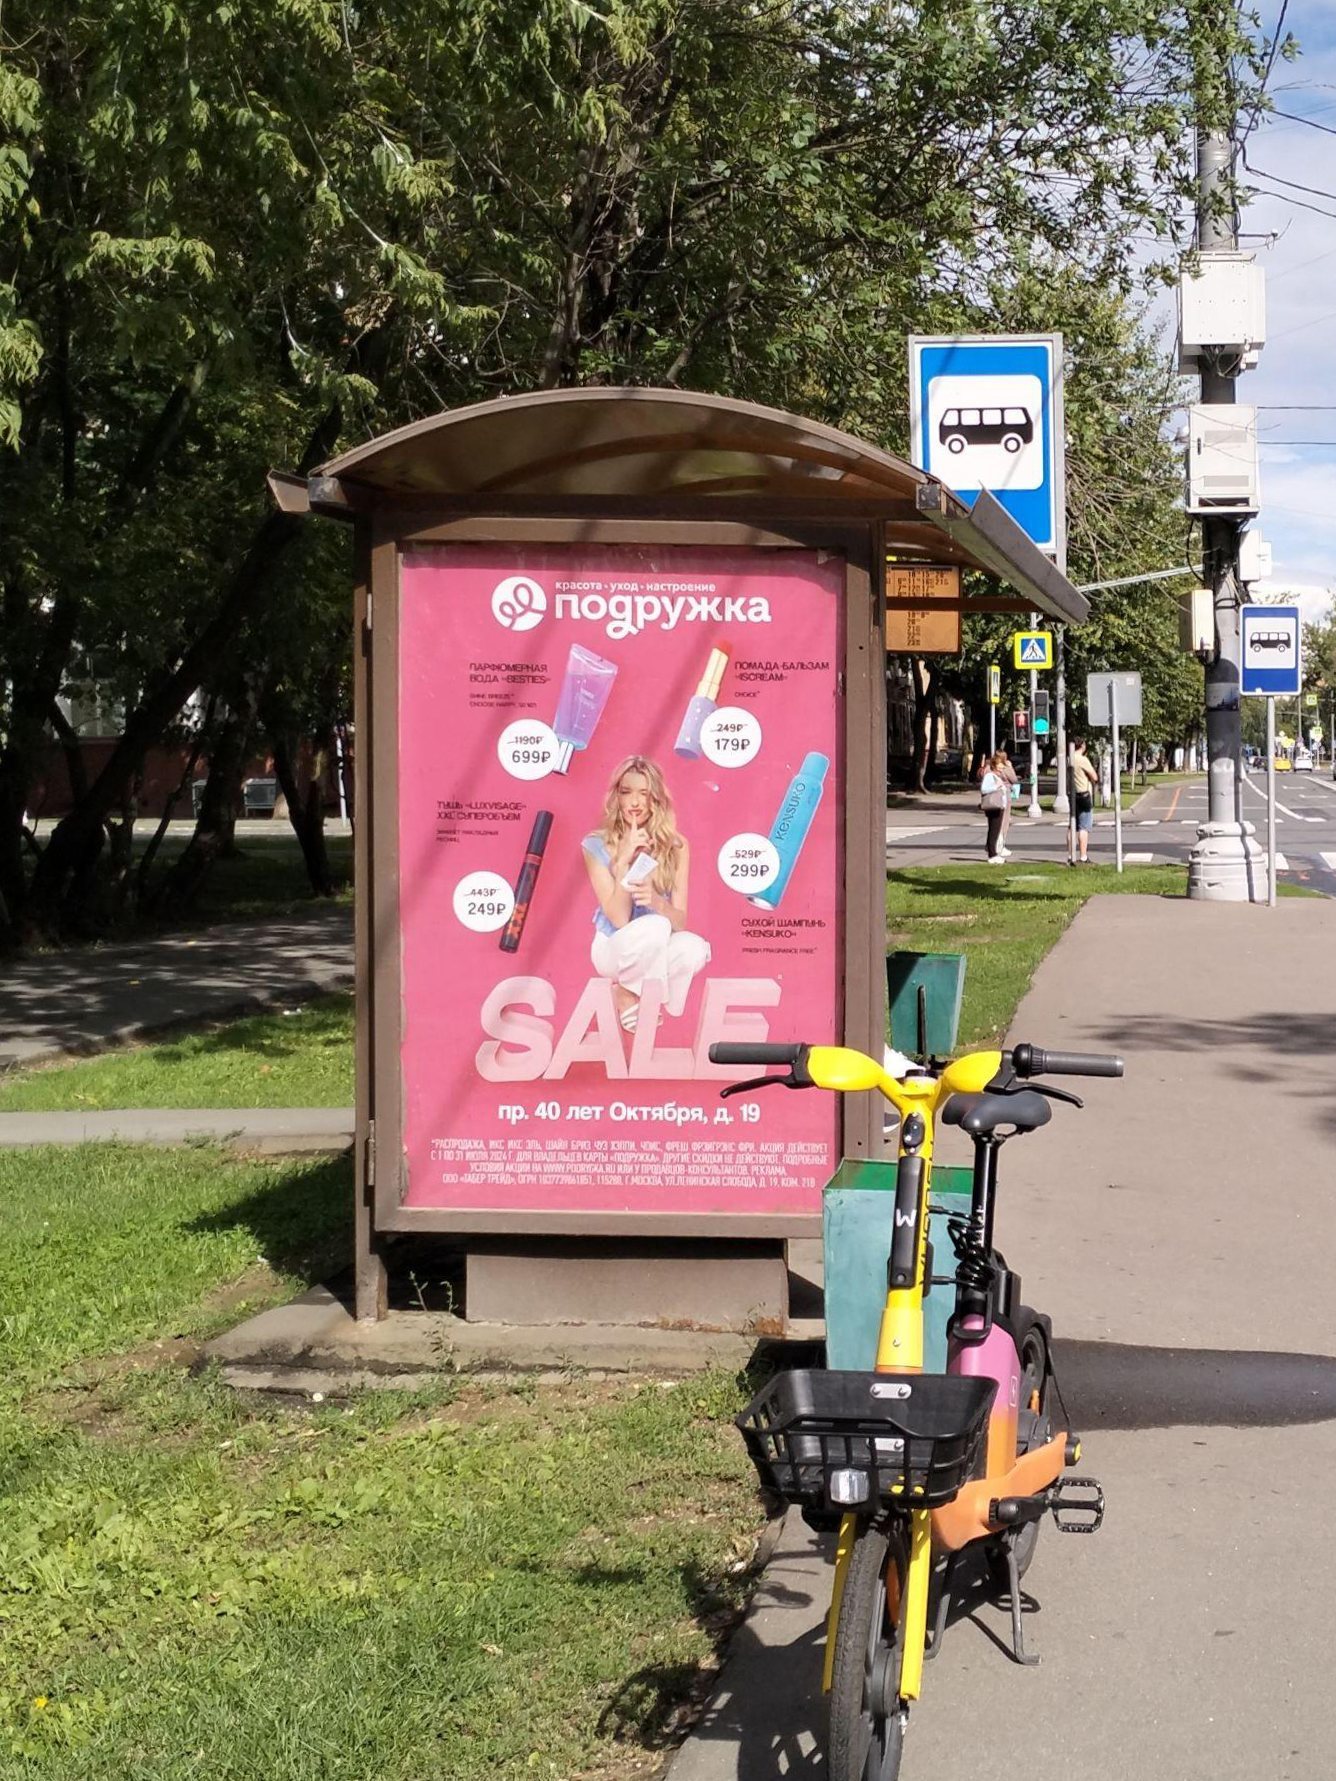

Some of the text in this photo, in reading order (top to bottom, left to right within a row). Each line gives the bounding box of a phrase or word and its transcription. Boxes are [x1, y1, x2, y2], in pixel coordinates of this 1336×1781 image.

[555, 581, 716, 594] красота уход настроение
[555, 594, 771, 640] подружка
[469, 662, 548, 673] ПАРФЮМЕРНАЯ
[469, 674, 499, 684] ВОДА
[498, 1101, 761, 1126] пр. 40 лет Октября, д. 19
